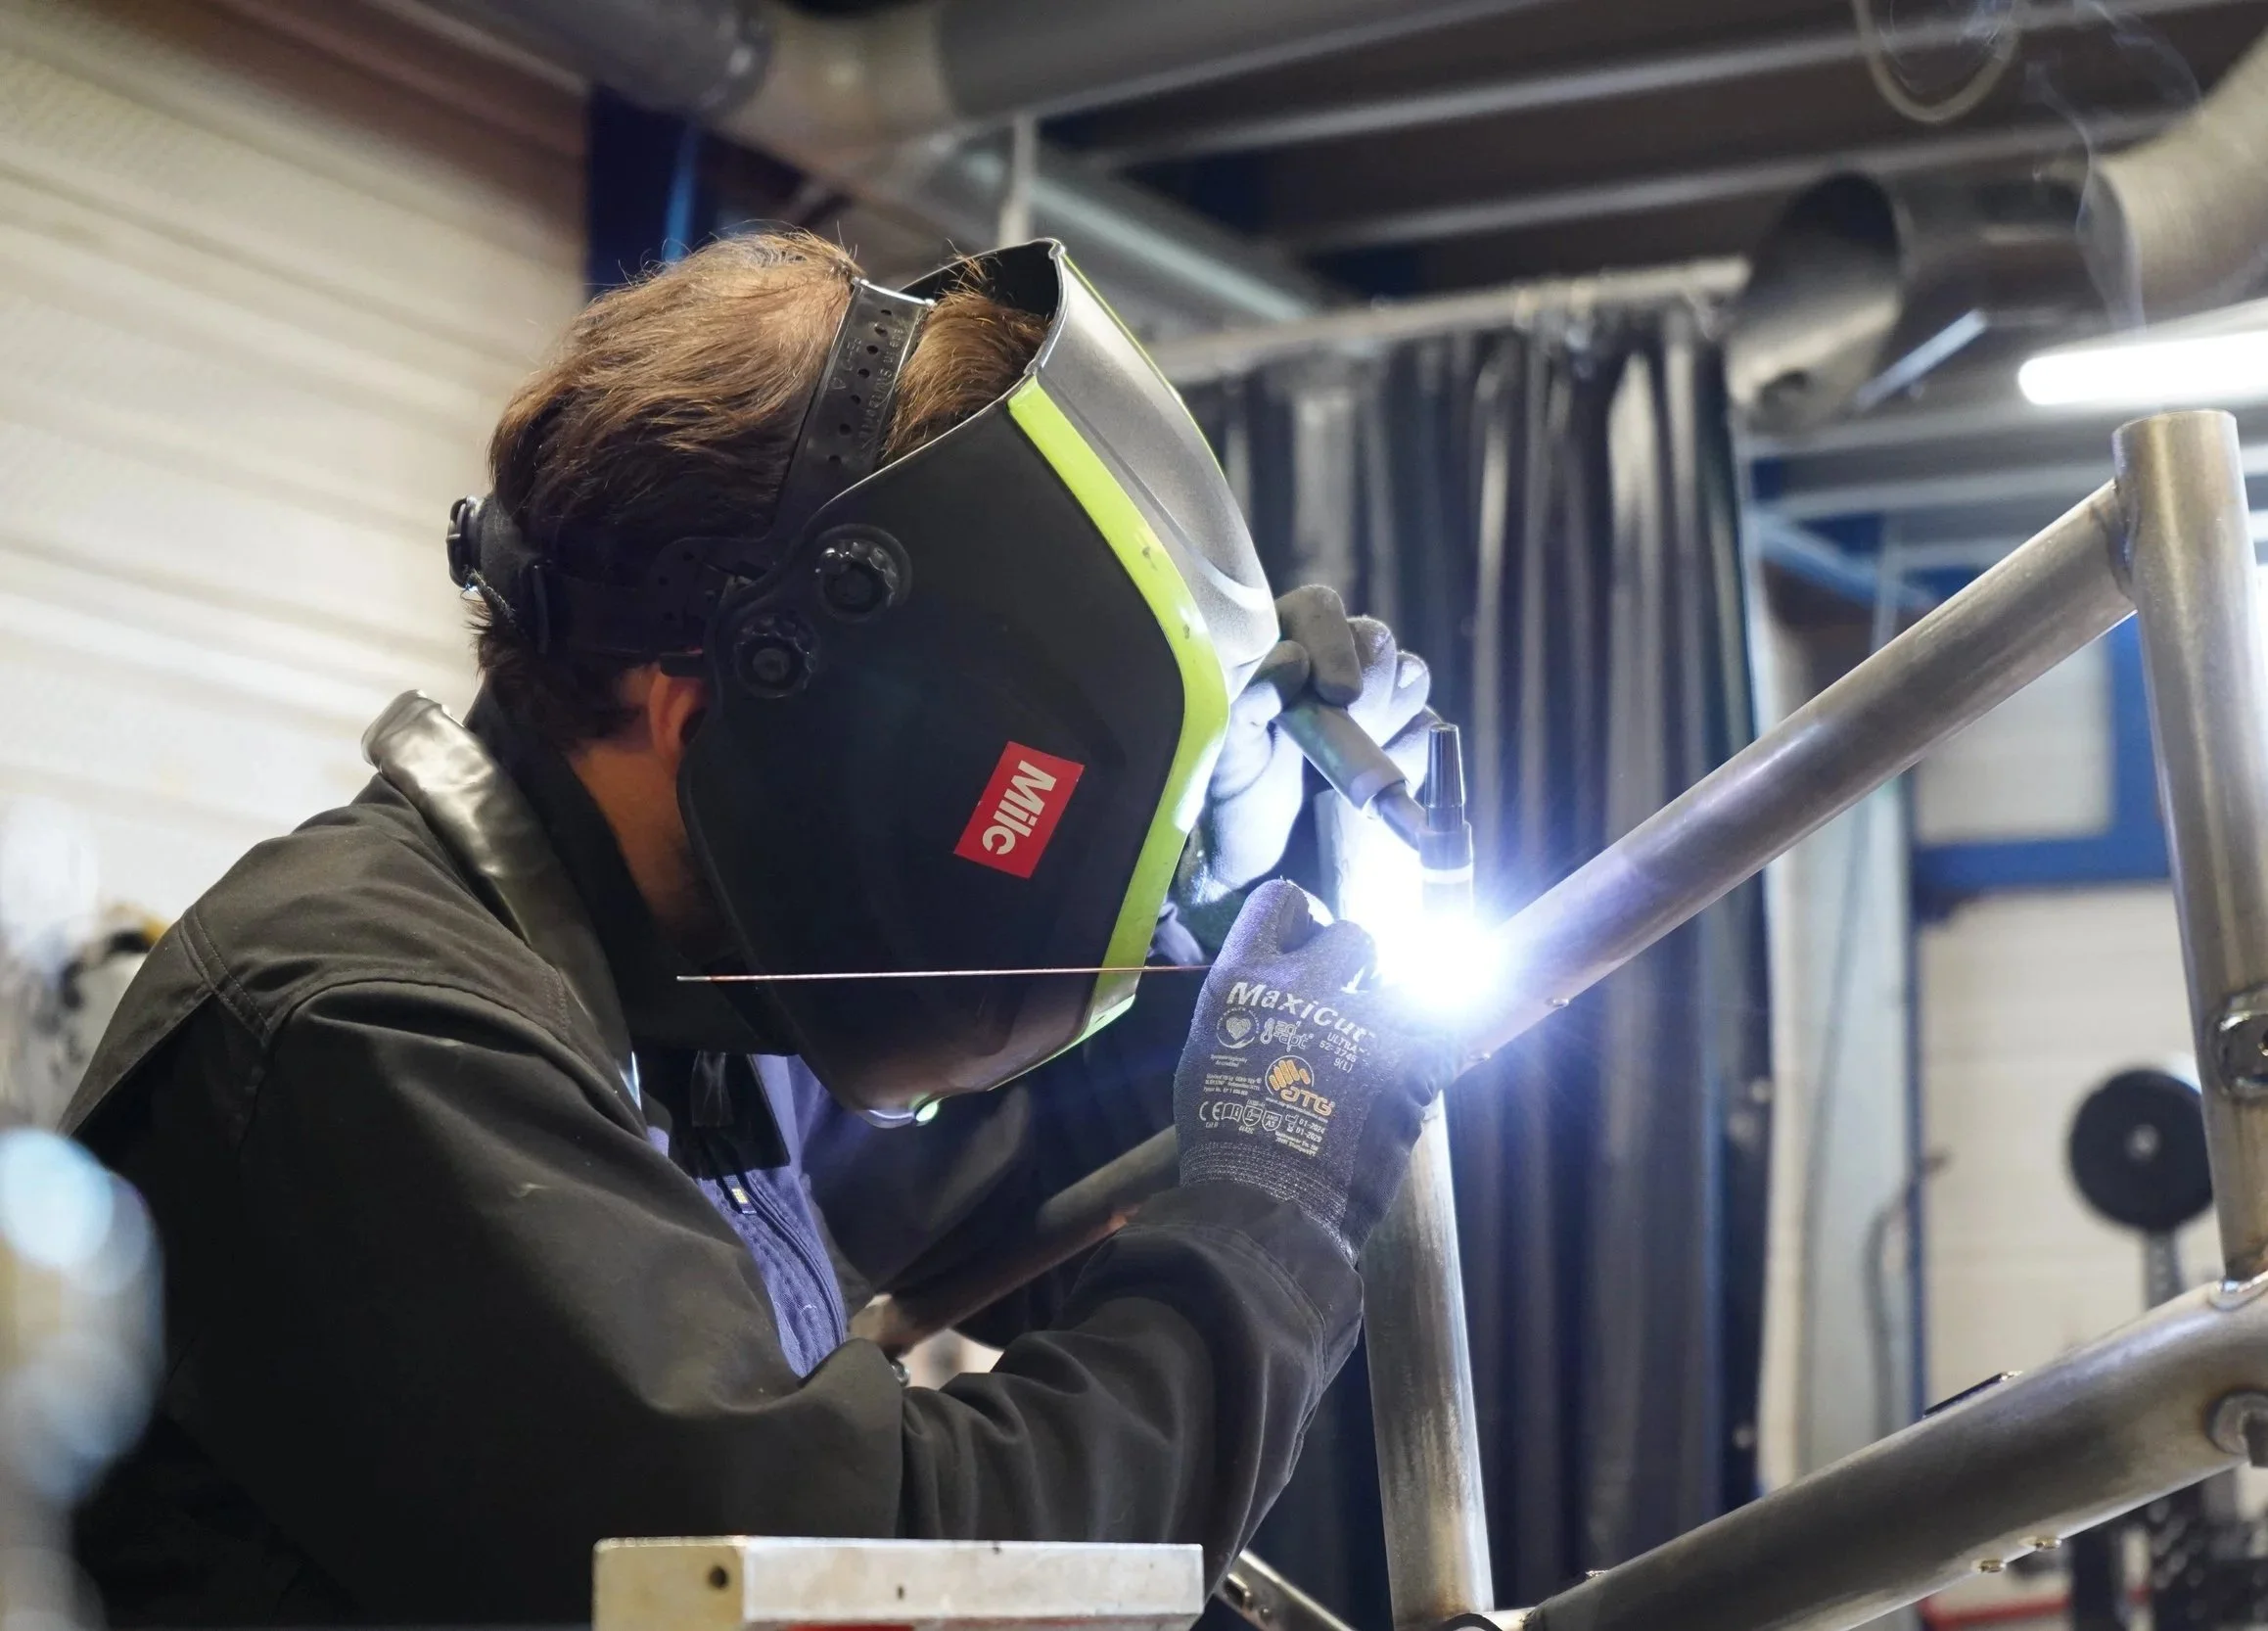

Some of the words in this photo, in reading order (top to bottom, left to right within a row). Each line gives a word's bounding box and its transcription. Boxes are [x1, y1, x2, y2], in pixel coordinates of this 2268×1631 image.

[983, 760, 1056, 855] Milc
[1227, 981, 1365, 1042] MaxiCut
[1319, 1040, 1357, 1063] 52-3745
[1326, 1032, 1357, 1054] ULTRA
[1299, 1118, 1326, 1135] 01-2024
